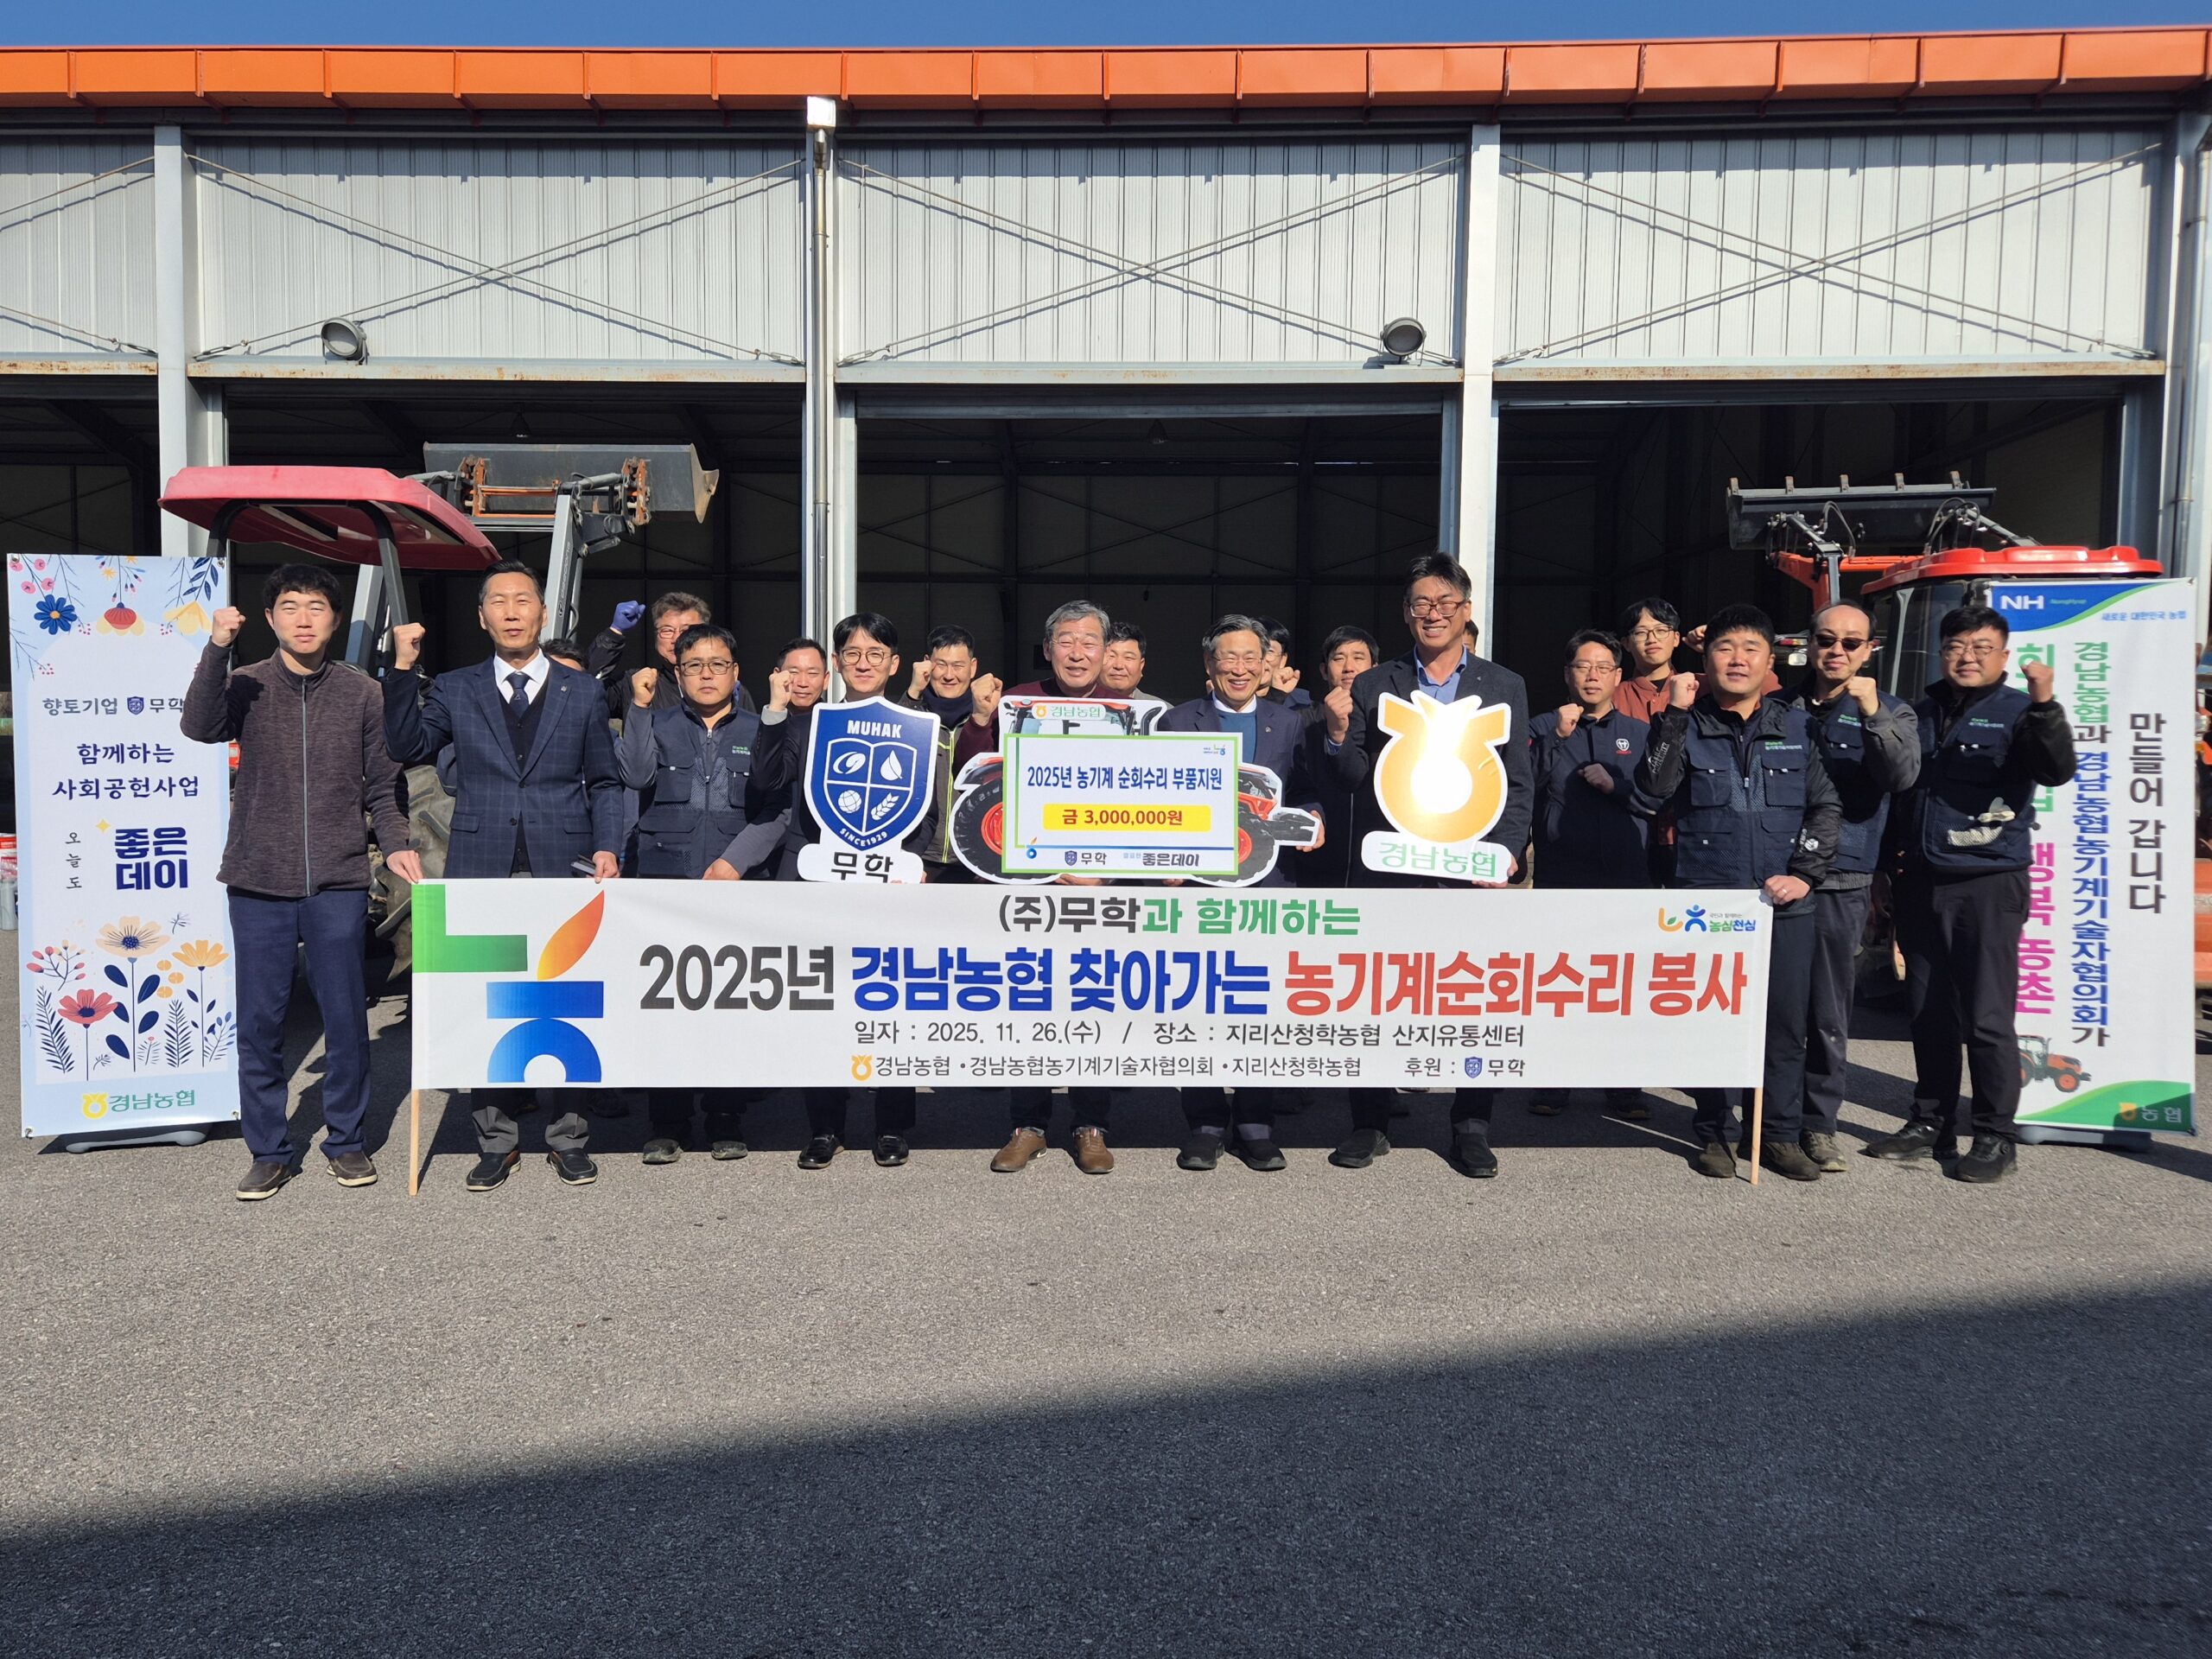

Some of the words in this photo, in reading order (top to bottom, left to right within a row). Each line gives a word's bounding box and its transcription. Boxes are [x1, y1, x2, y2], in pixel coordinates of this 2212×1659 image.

[1999, 594, 2045, 610] NH
[42, 697, 118, 716] 향토기업
[149, 697, 185, 715] 무학
[1051, 704, 1102, 718] 경남농협
[847, 720, 902, 739] MUHAK
[76, 742, 175, 765] 함께하는
[2129, 713, 2166, 807] 만들어
[52, 776, 199, 800] 사회공헌사업
[1027, 766, 1072, 788] 2025년
[1077, 766, 1114, 789] 농기계
[1118, 766, 1167, 790] 순회수리
[1173, 767, 1222, 791] 부품지원
[1062, 809, 1077, 824] 금
[1084, 810, 1183, 826] 3,000,000원
[114, 826, 188, 860] 좋은
[830, 851, 894, 884] 무학
[1080, 851, 1108, 866] 무학
[1142, 852, 1200, 867] 좋은데이
[1379, 842, 1497, 878] 경남농협
[2128, 819, 2166, 913] 갑니다
[116, 858, 188, 891] 데이
[999, 894, 1183, 934] (주)무학과
[1197, 898, 1361, 936] 함께하는
[1709, 919, 1757, 932] 농심천심
[639, 944, 835, 1012] 2025년
[851, 946, 1052, 1012] 경남농협
[1070, 947, 1270, 1014] 찾아가는
[1285, 950, 1635, 1018] 농기계순회수리
[1649, 951, 1748, 1016] 봉사
[855, 1020, 899, 1045] 일자
[926, 1022, 985, 1045] 2025.
[996, 1022, 1020, 1044] 11.
[1122, 1021, 1133, 1045] /
[1154, 1022, 1198, 1045] 장소
[1225, 1023, 1381, 1046] 지리산청학농협
[1392, 1024, 1524, 1047] 산지유통센터
[875, 1055, 950, 1077] 경남농협
[1404, 1057, 1441, 1077] 후원
[1488, 1058, 1526, 1077] 무학
[109, 1090, 194, 1112] 경남농협
[2141, 1105, 2182, 1122] 농협
